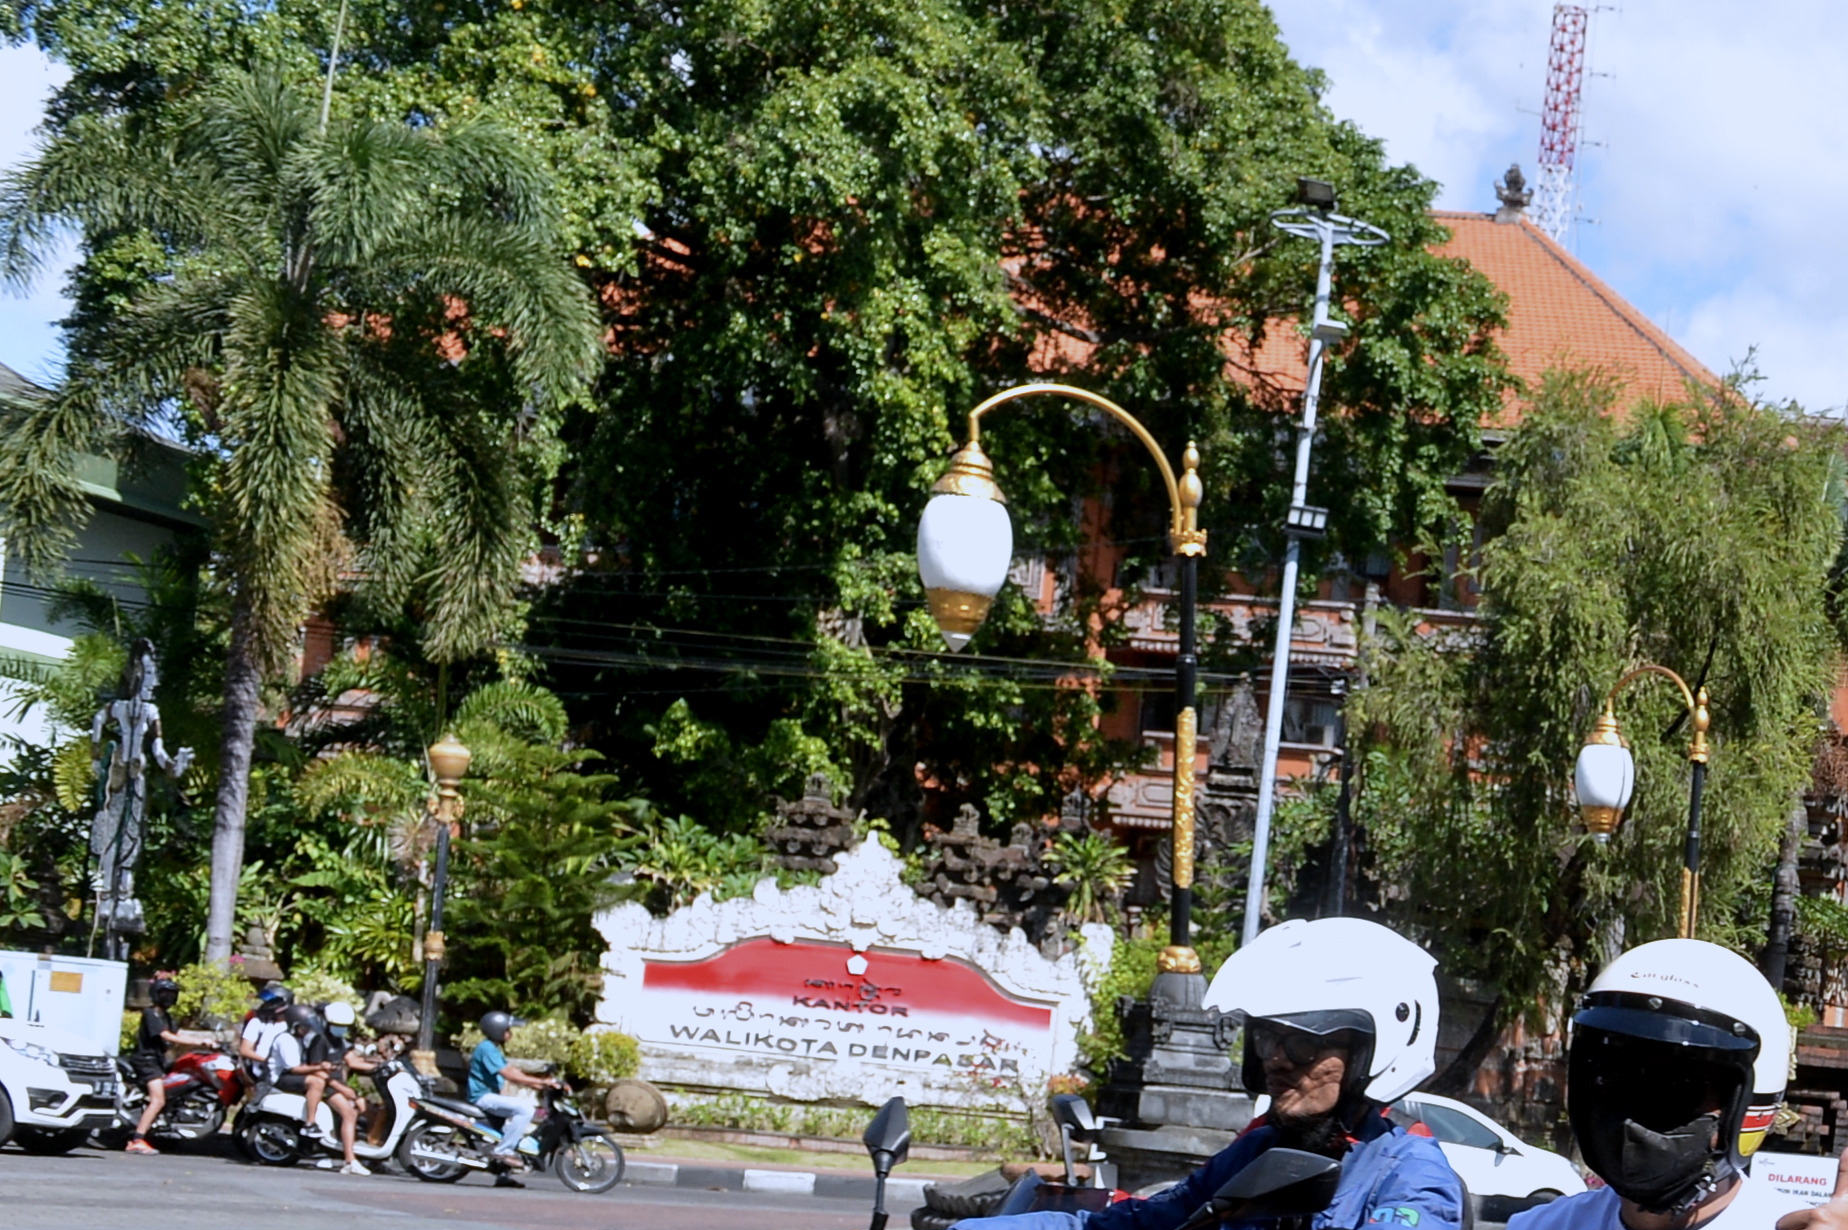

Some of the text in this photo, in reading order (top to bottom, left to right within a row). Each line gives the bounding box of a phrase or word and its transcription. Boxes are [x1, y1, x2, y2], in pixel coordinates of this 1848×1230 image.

[793, 996, 909, 1017] KANTOR
[670, 1024, 838, 1056] WALIKOTA
[849, 1043, 1019, 1072] DENPASAR
[1768, 1173, 1827, 1186] DILARANG
